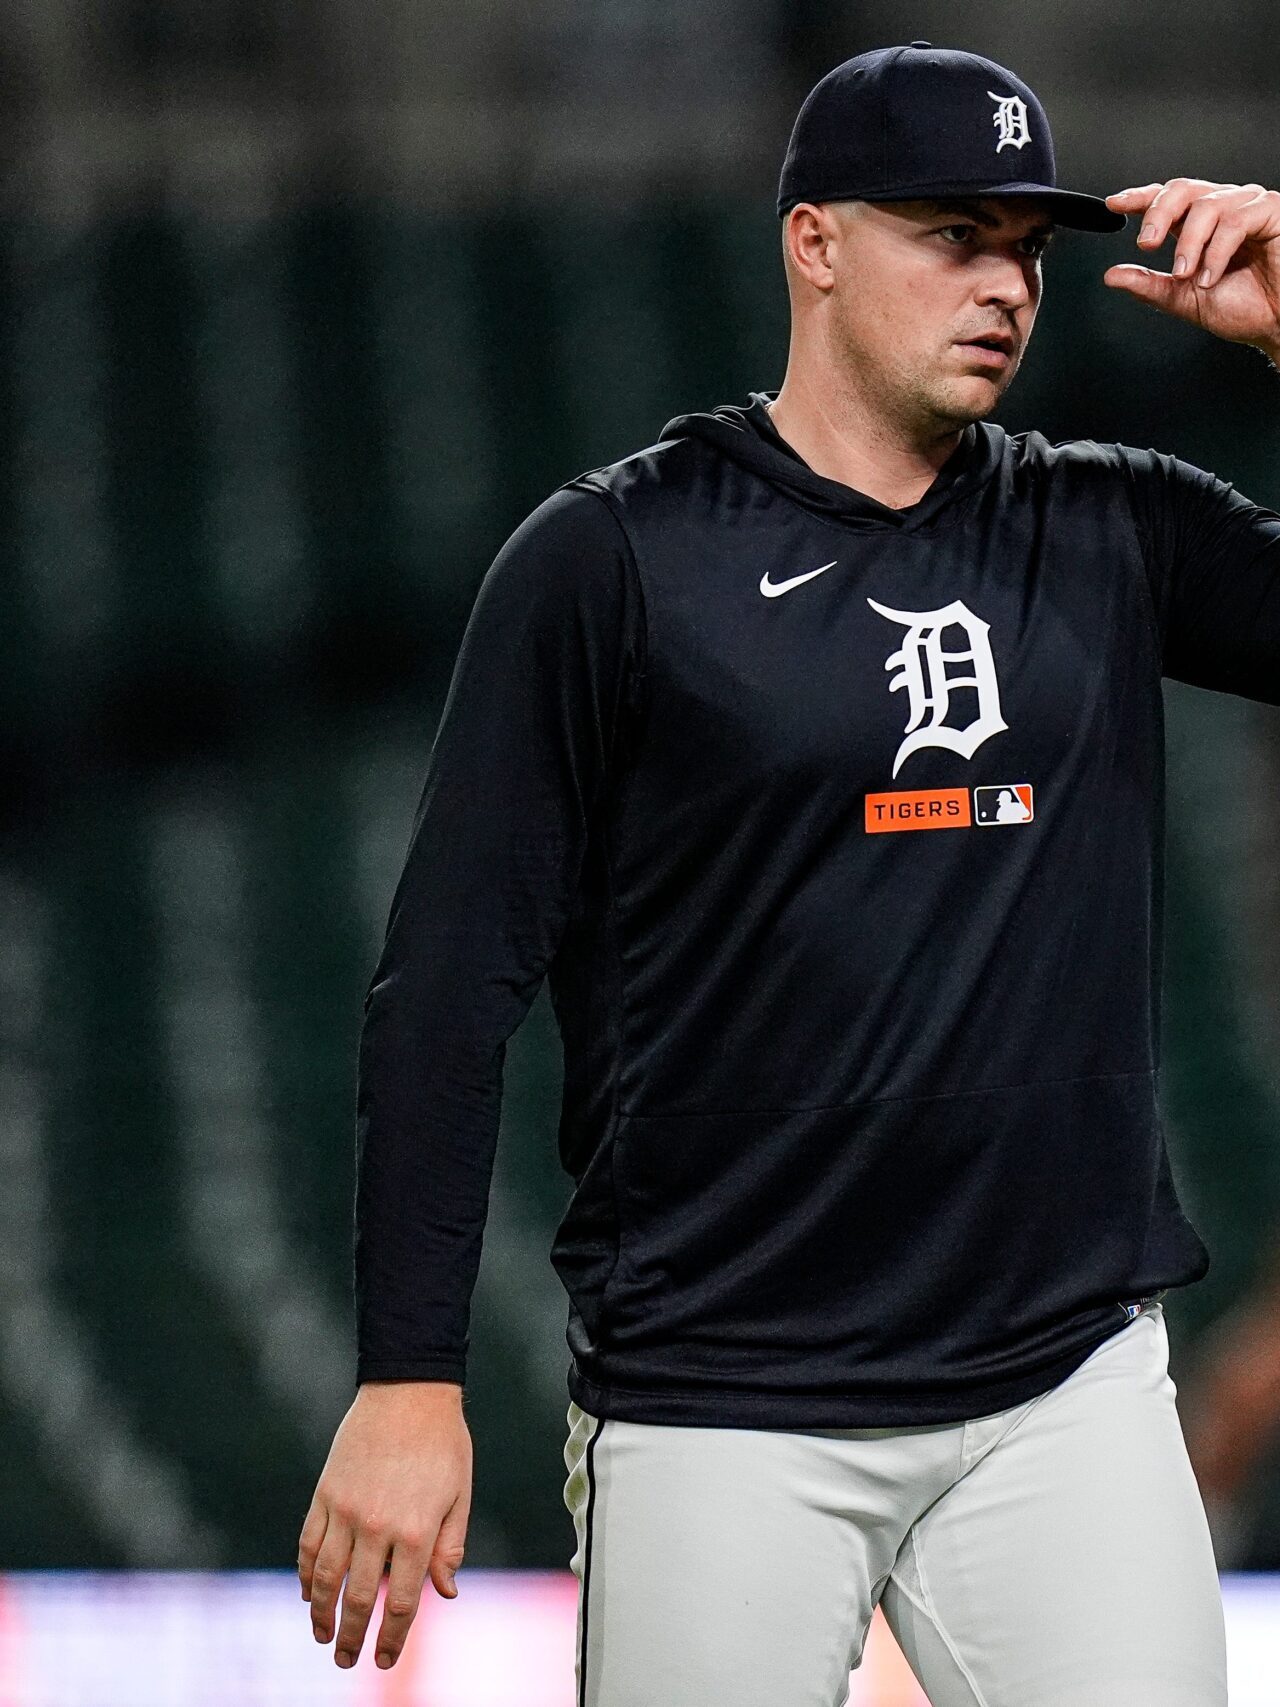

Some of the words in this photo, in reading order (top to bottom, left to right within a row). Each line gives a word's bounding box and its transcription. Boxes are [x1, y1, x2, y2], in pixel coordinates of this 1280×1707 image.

[986, 90, 1033, 154] D
[866, 597, 1009, 780] D
[873, 799, 961, 821] TIGERS
